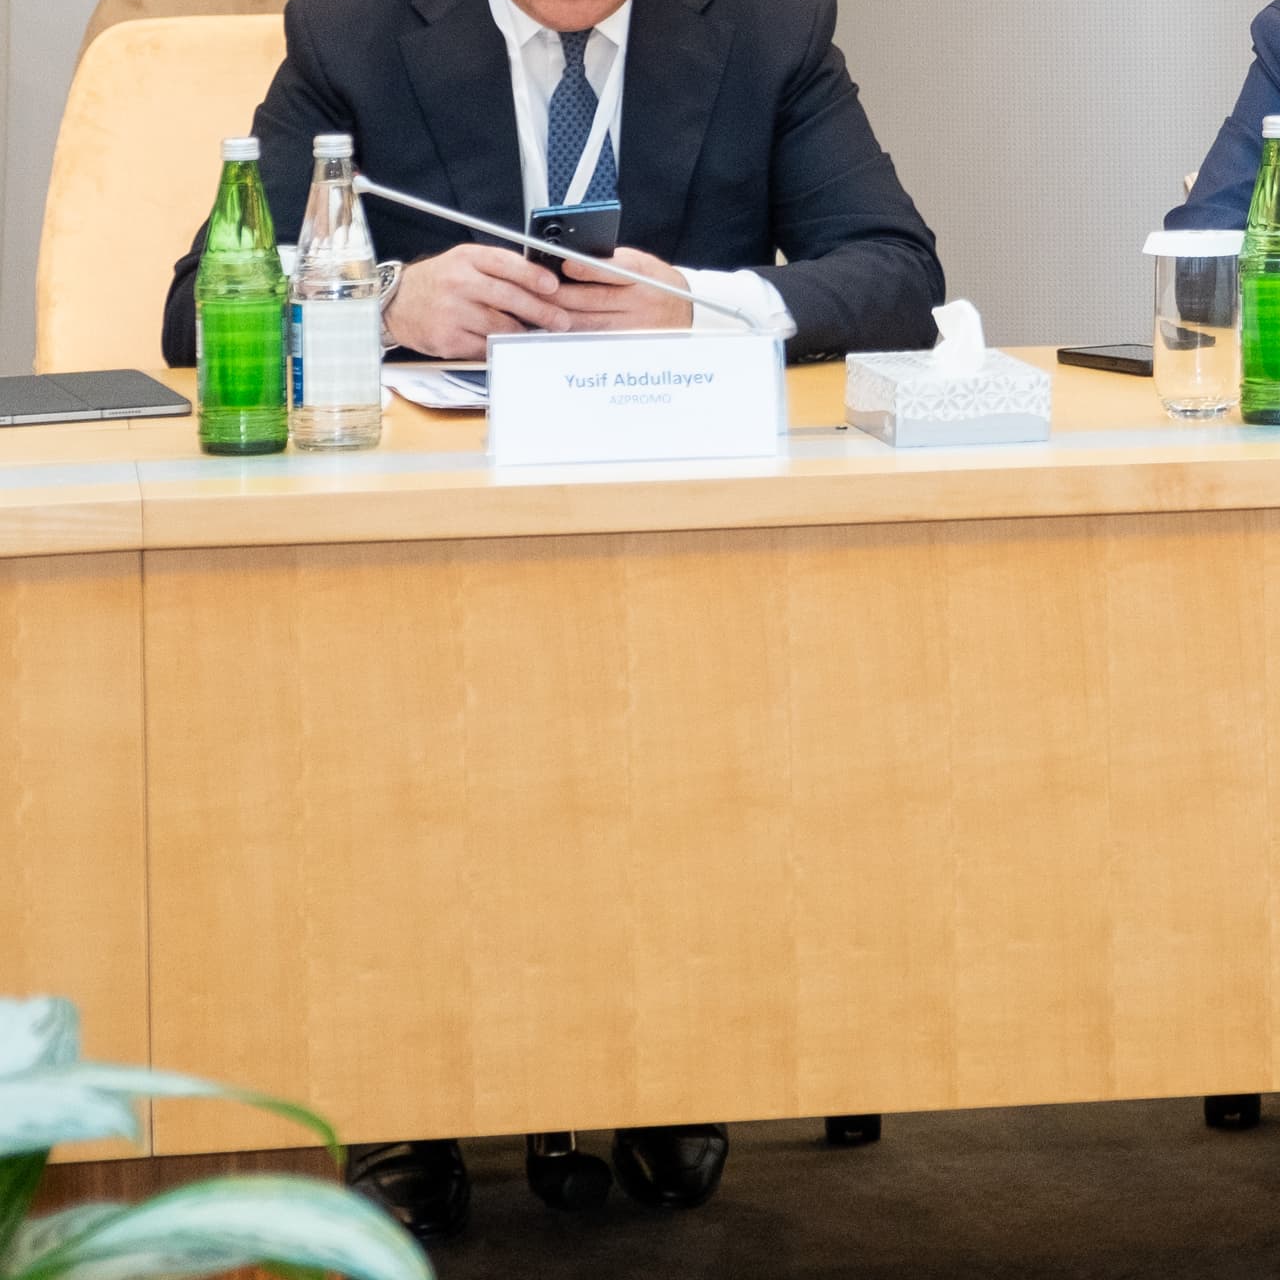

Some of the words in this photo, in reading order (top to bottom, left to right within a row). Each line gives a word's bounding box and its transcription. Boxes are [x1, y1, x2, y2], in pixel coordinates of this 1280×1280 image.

[564, 372, 609, 388] Yusif
[613, 370, 715, 388] Abdullayev
[608, 393, 673, 405] AZPROMO
